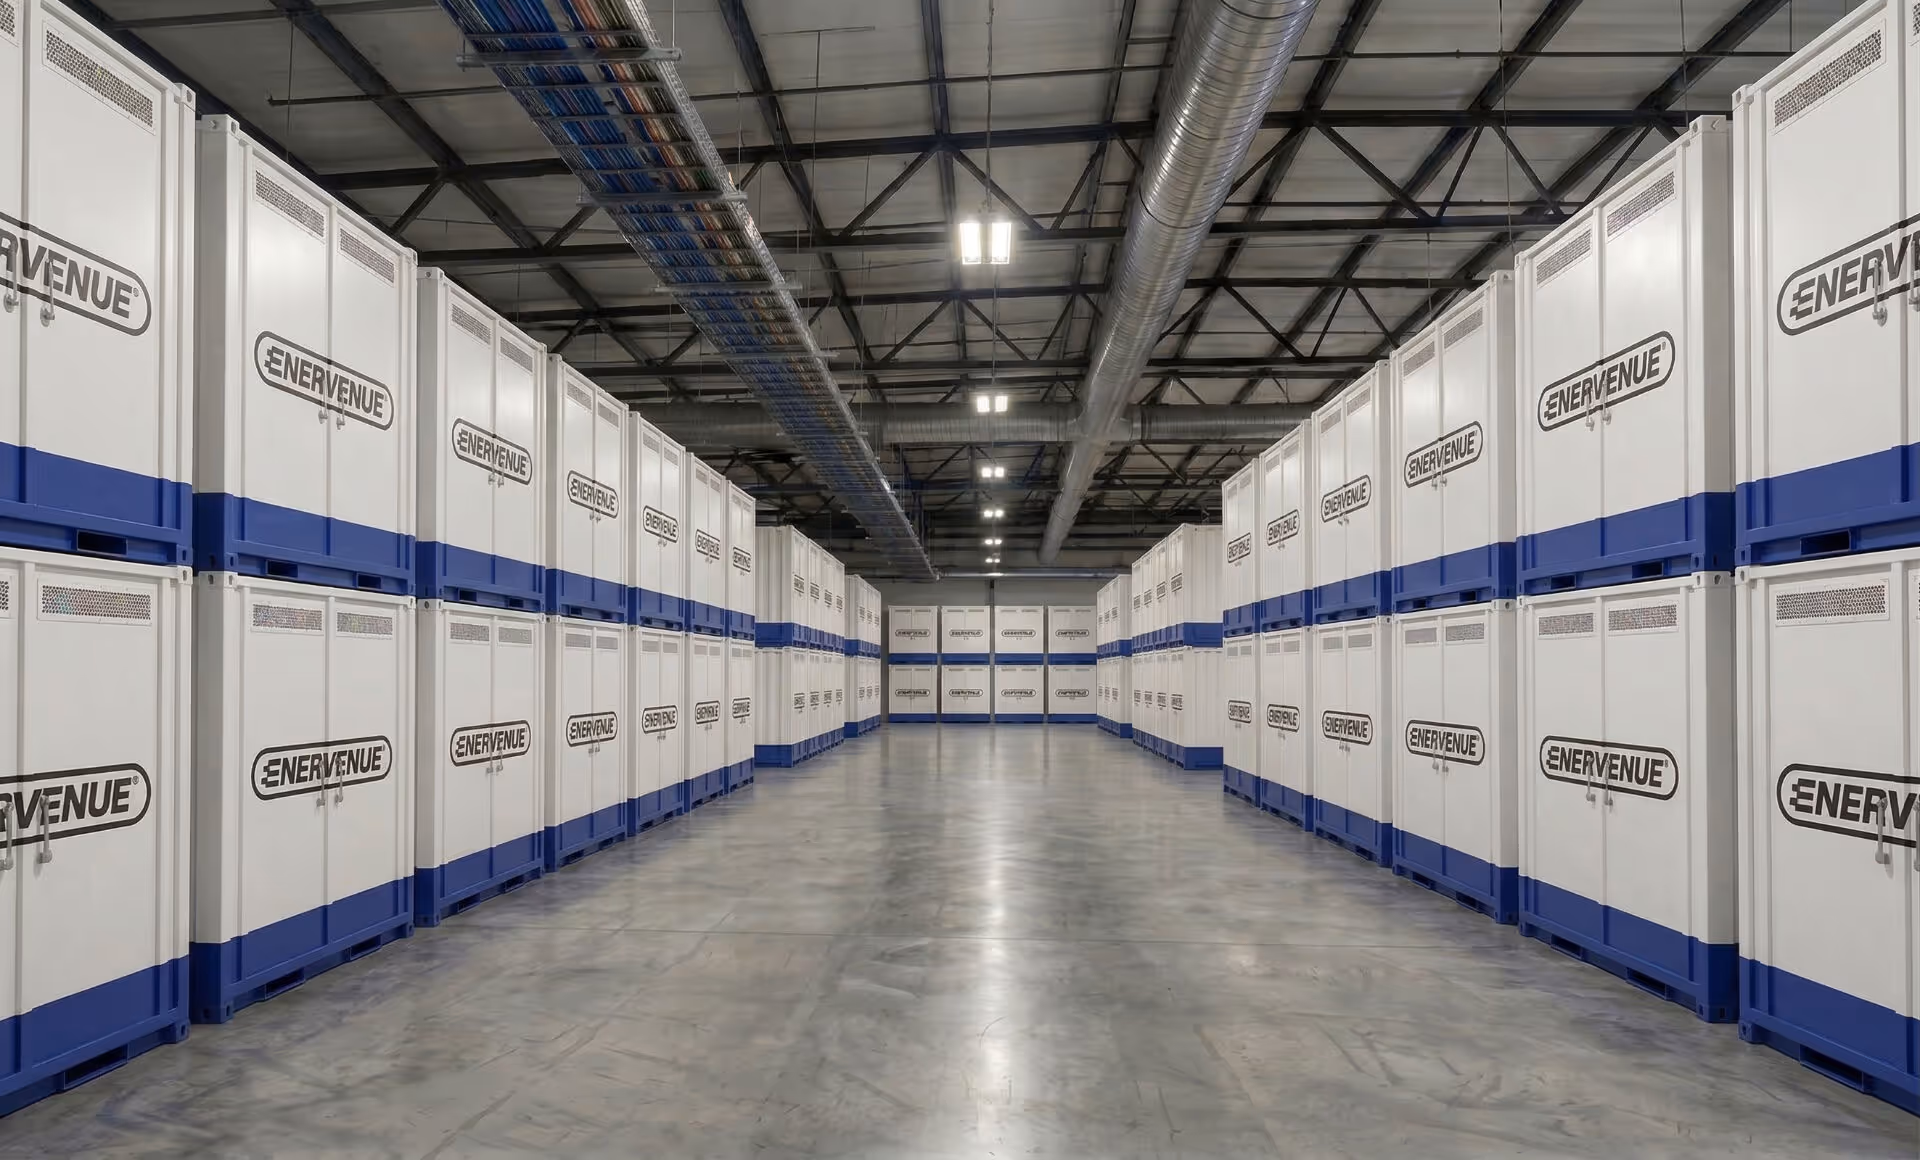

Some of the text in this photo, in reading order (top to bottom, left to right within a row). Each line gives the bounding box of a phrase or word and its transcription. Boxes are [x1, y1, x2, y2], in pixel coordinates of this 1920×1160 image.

[264, 345, 384, 419] ENERVENUE
[1544, 344, 1661, 420] ENERVENUE
[456, 428, 527, 476] ENERVENUE
[1408, 430, 1475, 480] ENERVENUE
[570, 478, 616, 512] ENERVENUE
[455, 727, 526, 758] ENERVENUE
[1409, 727, 1477, 757] ENERVENUE
[261, 745, 382, 788] ENERVENUE
[1546, 745, 1664, 788] ENERVENUE
